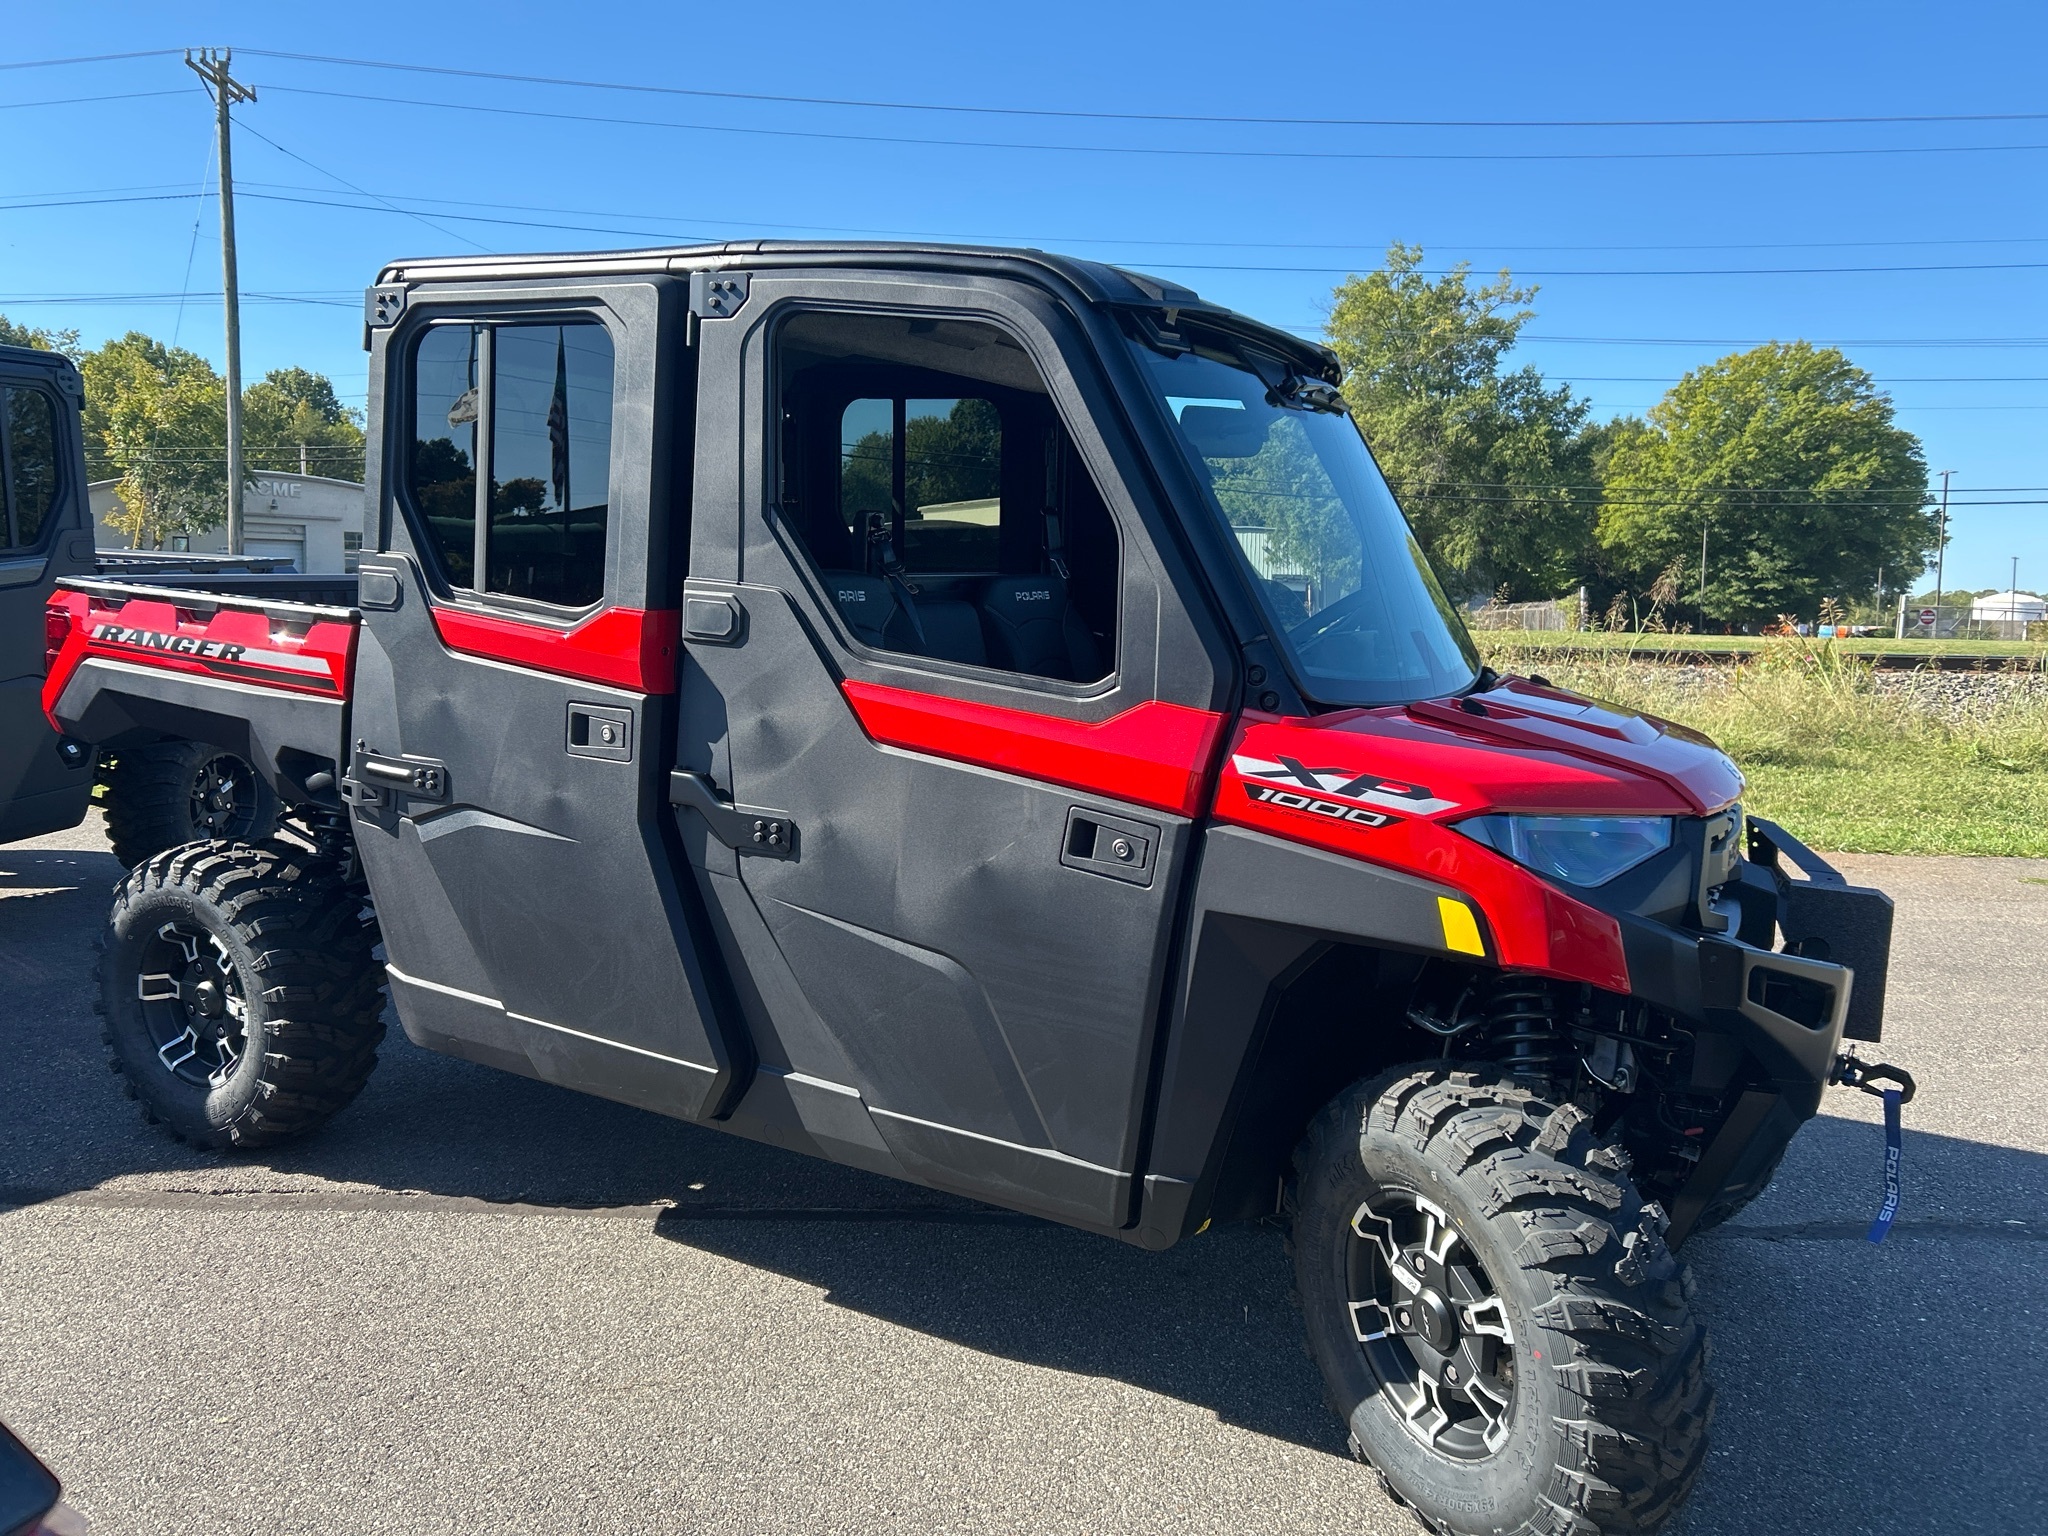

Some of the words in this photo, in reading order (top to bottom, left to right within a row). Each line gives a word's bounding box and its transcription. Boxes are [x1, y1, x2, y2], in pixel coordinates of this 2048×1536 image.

[1015, 590, 1050, 602] POLARIS
[99, 625, 247, 663] RANGER
[1243, 753, 1435, 801] XP
[1257, 788, 1387, 827] 1000
[1878, 1146, 1899, 1222] POLARIS
